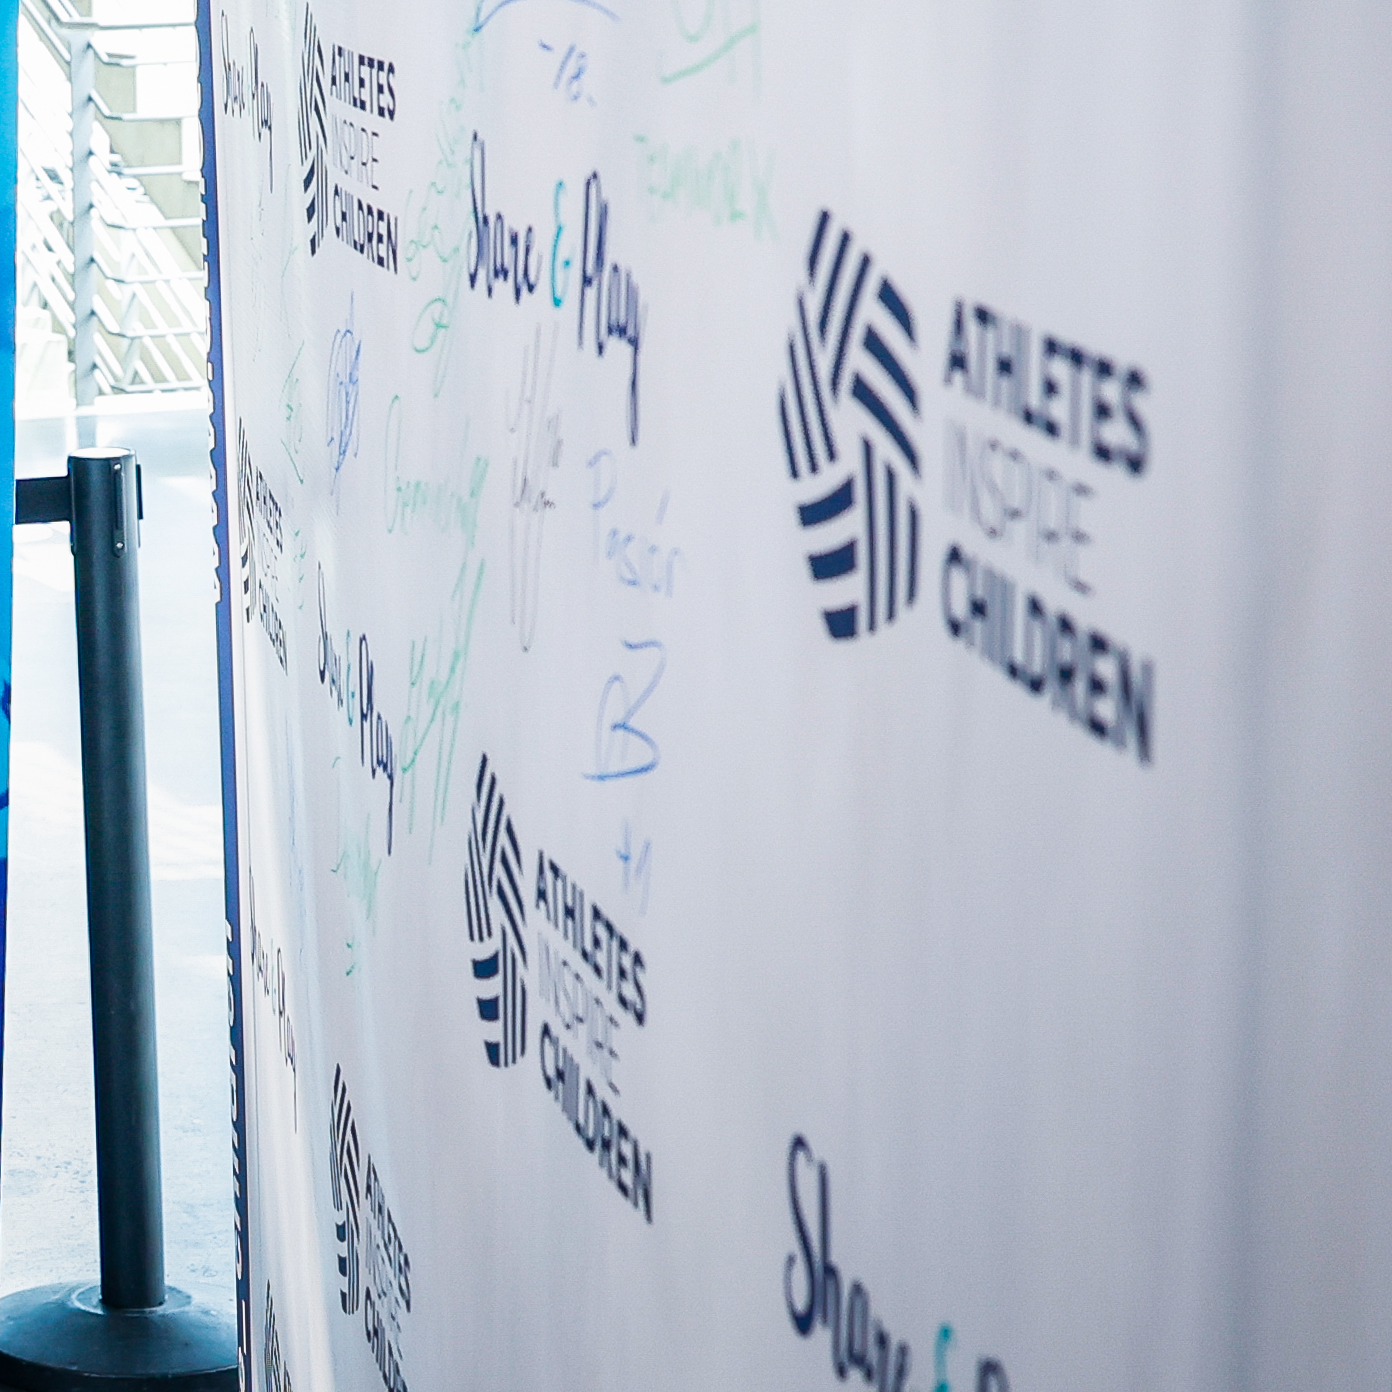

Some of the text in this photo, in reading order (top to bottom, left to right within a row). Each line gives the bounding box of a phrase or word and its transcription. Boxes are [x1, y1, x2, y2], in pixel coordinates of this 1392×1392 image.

[329, 43, 397, 122] ATHLETES
[330, 112, 380, 192] INSPIRE
[332, 182, 399, 275] CHILDREN
[468, 131, 543, 305] Share
[550, 181, 572, 308] &
[577, 170, 647, 446] Play
[943, 297, 1153, 478] ATHLETES
[359, 632, 397, 857] Play
[941, 543, 1156, 768] CHILDREN
[535, 849, 647, 1028] ATHLETES
[539, 1020, 654, 1226] CHILDREN
[365, 1152, 412, 1314] ATHLETES
